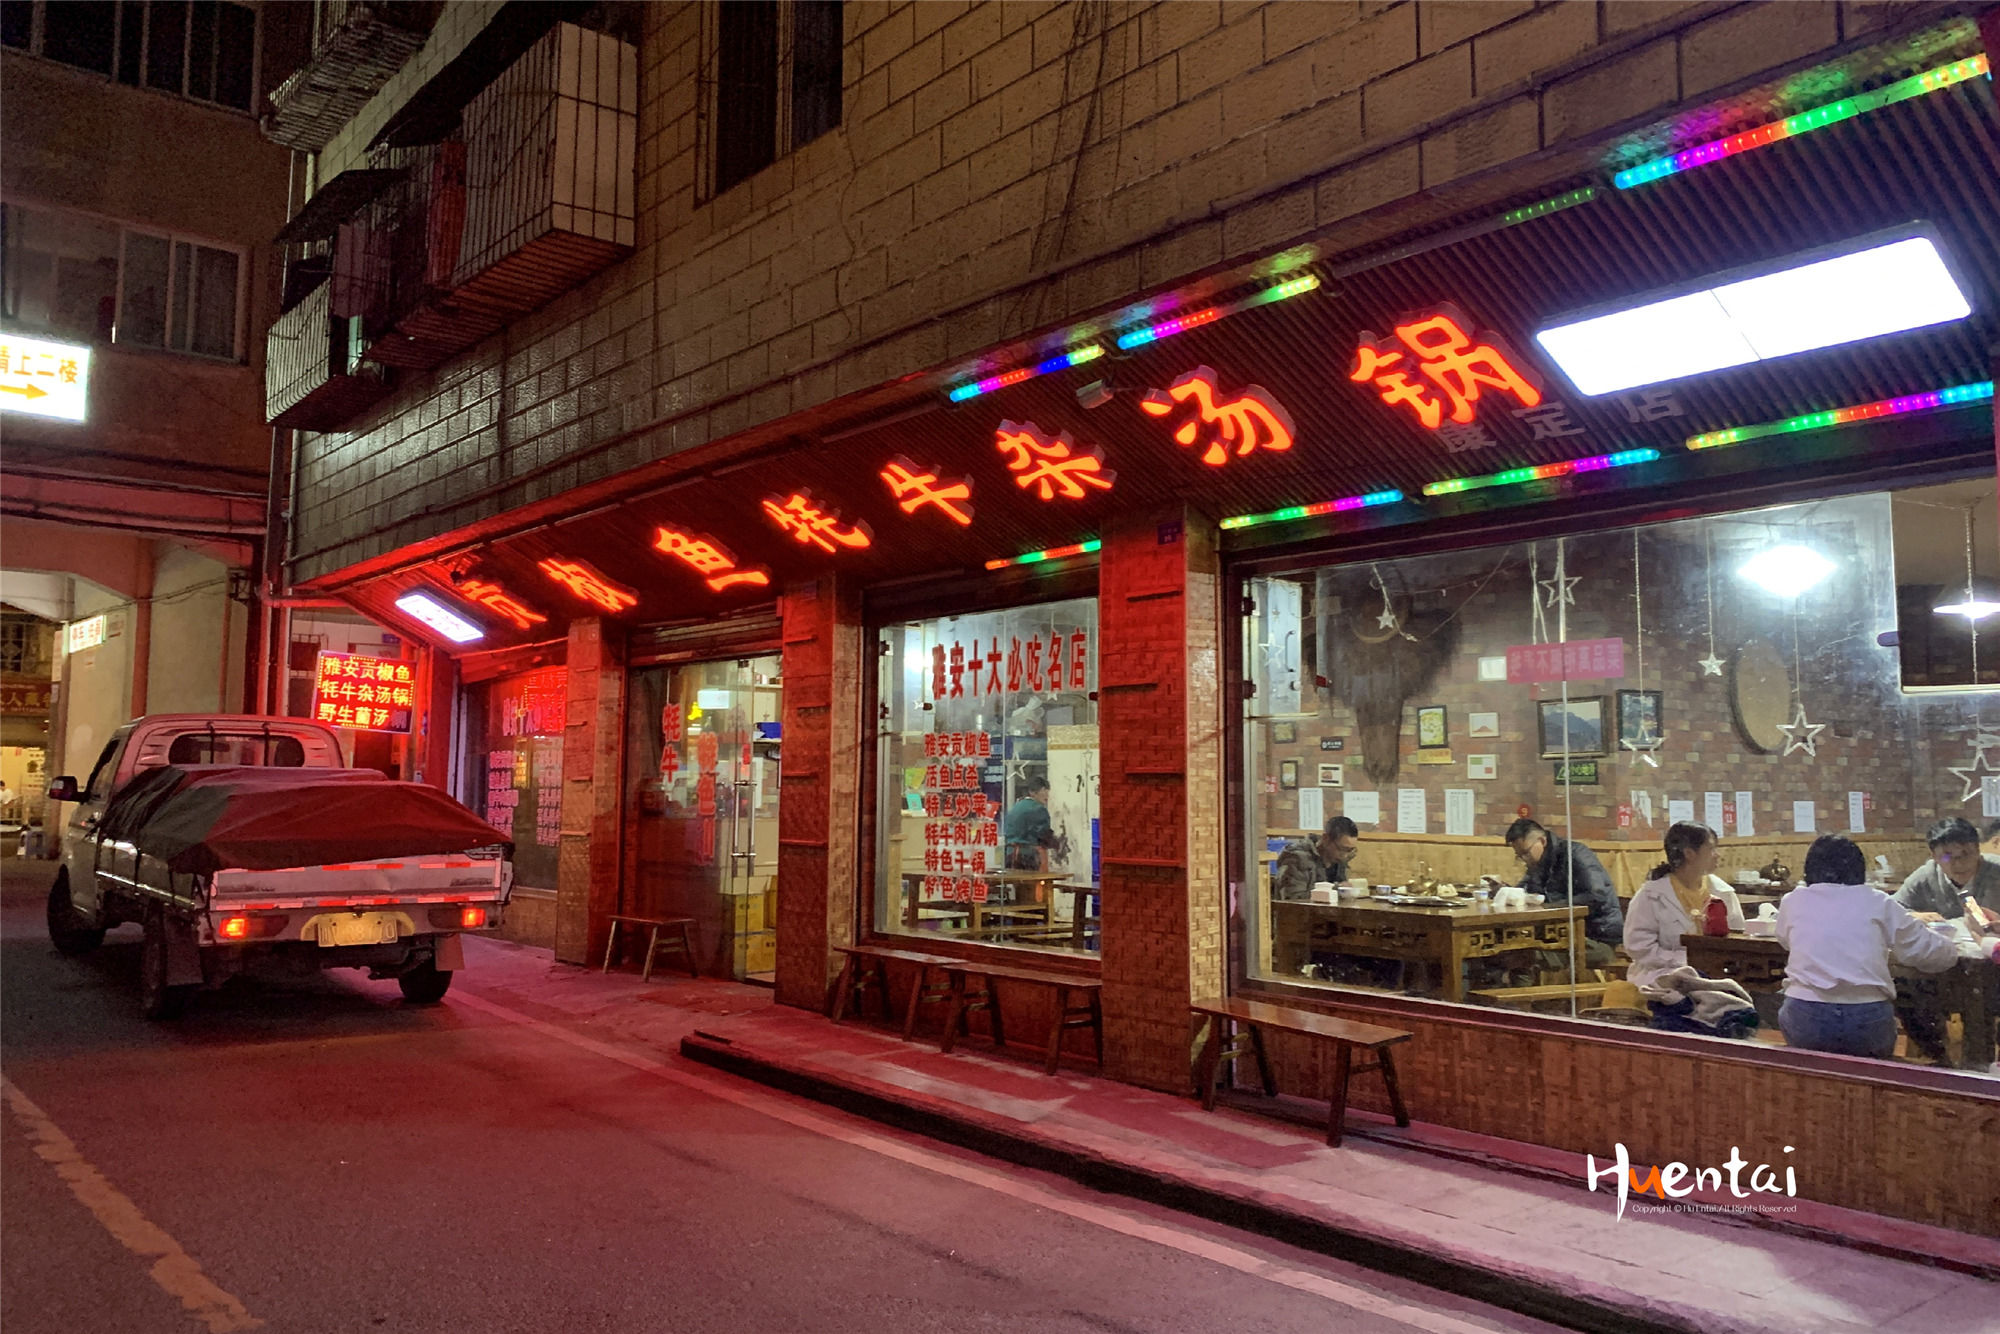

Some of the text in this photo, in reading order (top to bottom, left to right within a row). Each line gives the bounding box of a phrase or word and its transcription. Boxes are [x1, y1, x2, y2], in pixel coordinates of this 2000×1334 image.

[323, 656, 413, 683] 雅安贡椒鱼
[931, 627, 1087, 700] 雅安十大必吃名店
[320, 679, 410, 707] 牦牛杂汤锅
[924, 731, 991, 758] 雅安贡椒鱼
[925, 764, 978, 790] 活鱼点杀
[924, 793, 988, 818] 特色炒菜
[924, 822, 999, 848] 牦牛肉汤锅
[924, 848, 987, 875] 特色干锅
[924, 876, 988, 903] 特色烤鱼
